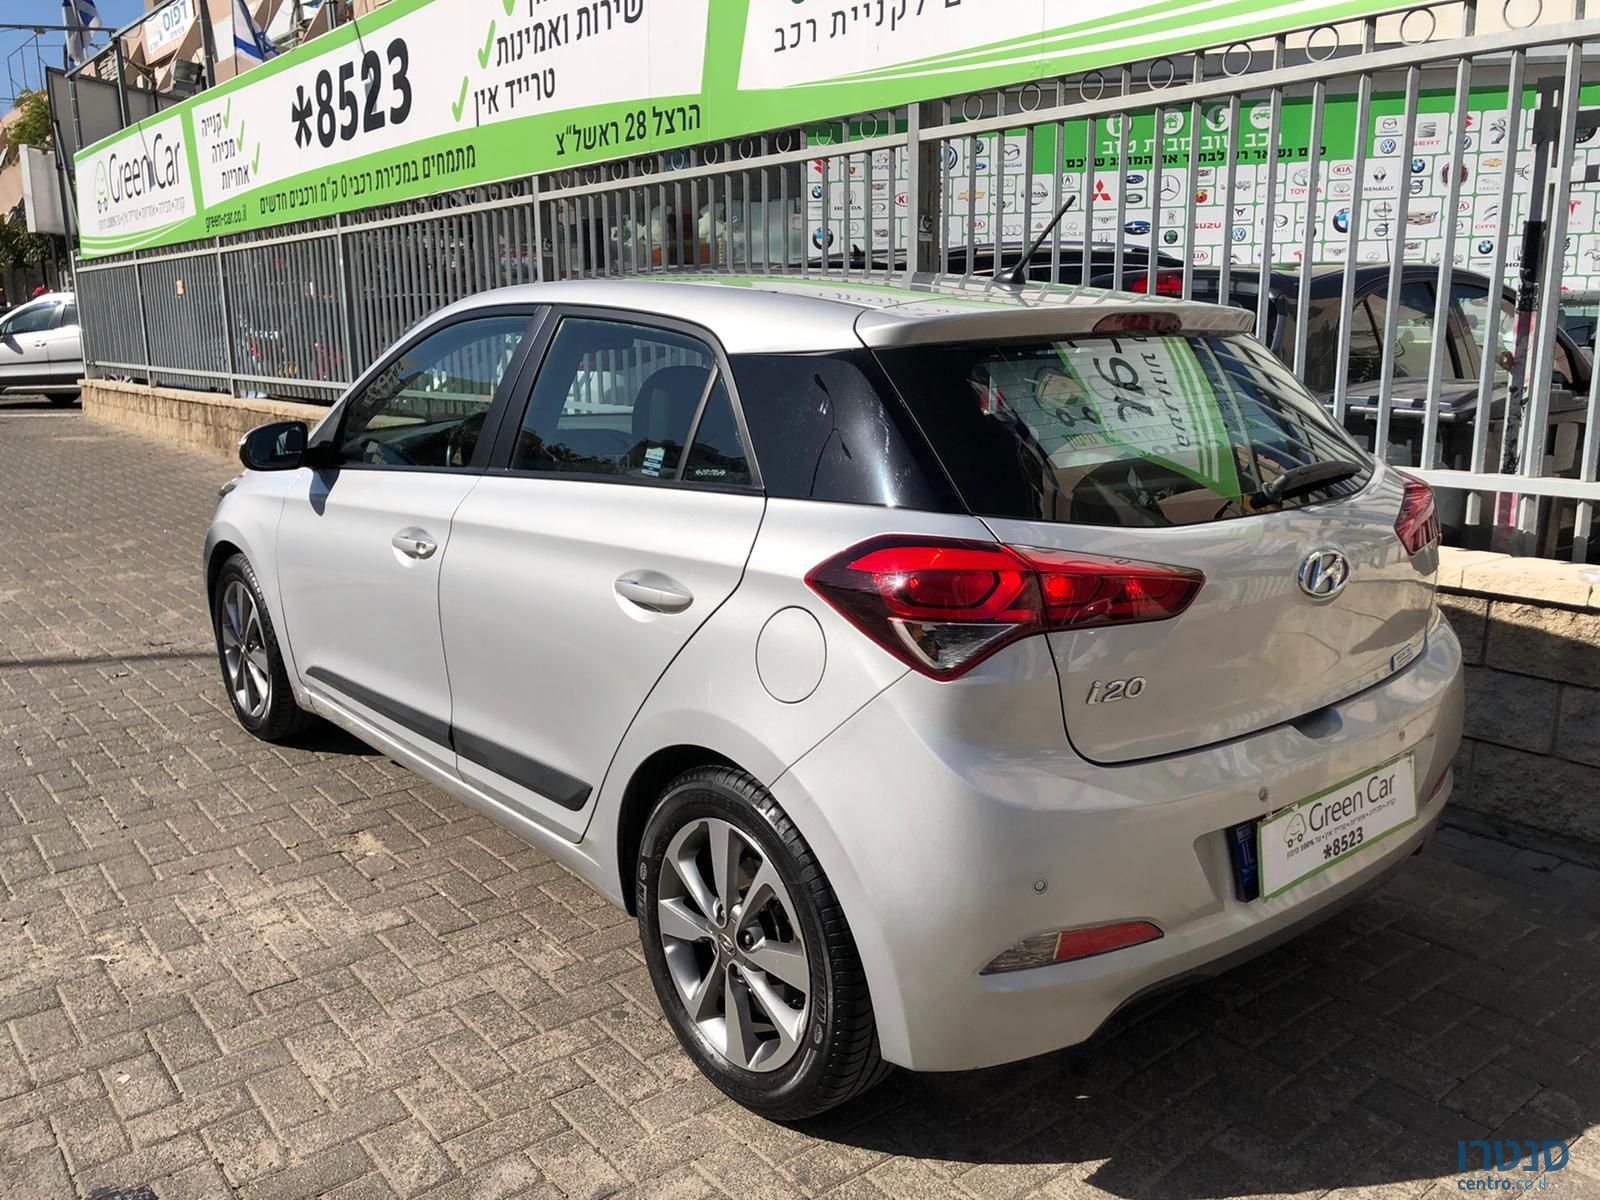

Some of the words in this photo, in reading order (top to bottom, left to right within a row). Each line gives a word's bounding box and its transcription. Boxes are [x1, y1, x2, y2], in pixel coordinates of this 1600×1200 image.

[576, 0, 644, 40] שירות
[774, 18, 817, 53] רכב
[497, 13, 569, 67] ואמינות
[504, 68, 556, 109] טרייד
[473, 84, 500, 128] אין
[652, 103, 701, 137] הרצל
[201, 112, 222, 138] קנייה
[625, 110, 647, 142] 28
[211, 138, 236, 164] מכירה
[422, 144, 476, 179] מתמחים
[109, 153, 152, 204] Green
[153, 132, 181, 189] Car
[221, 163, 250, 191] אחריות
[349, 171, 373, 196] רכבי
[375, 160, 419, 191] במכירת
[260, 192, 288, 215] חדשים
[290, 184, 318, 209] ורכבים
[205, 204, 248, 233] green-car.co.il
[1086, 676, 1147, 705] i20
[1309, 791, 1363, 832] Green
[1366, 774, 1396, 803] Car
